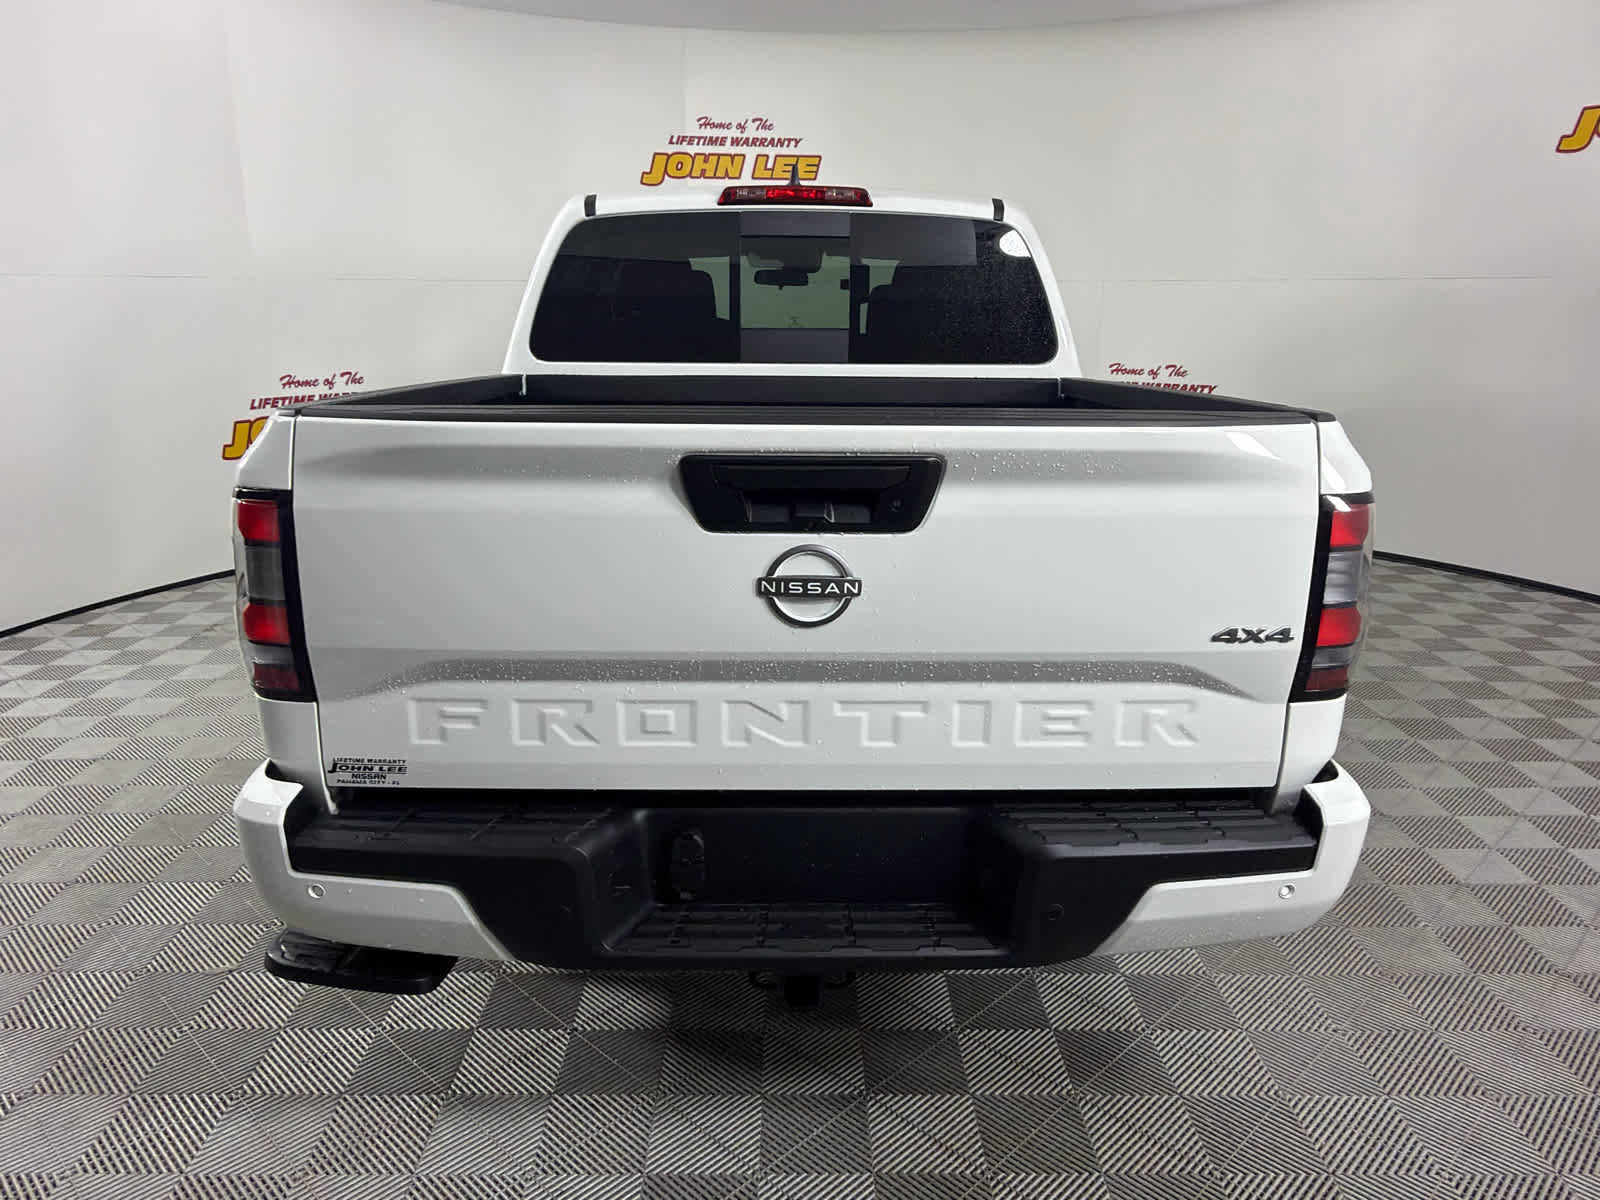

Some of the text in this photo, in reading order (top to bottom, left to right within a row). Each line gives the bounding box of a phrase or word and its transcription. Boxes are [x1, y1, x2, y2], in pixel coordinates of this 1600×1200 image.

[696, 116, 775, 134] Home of The
[668, 135, 803, 149] LIFETIME WARRANTY
[640, 151, 822, 186] JOHN LEE
[1108, 362, 1189, 380] Home of The
[279, 371, 365, 391] Home of The
[760, 580, 859, 595] NISSAN
[407, 696, 1201, 750] FRONTIER
[328, 762, 374, 774] JOHN
